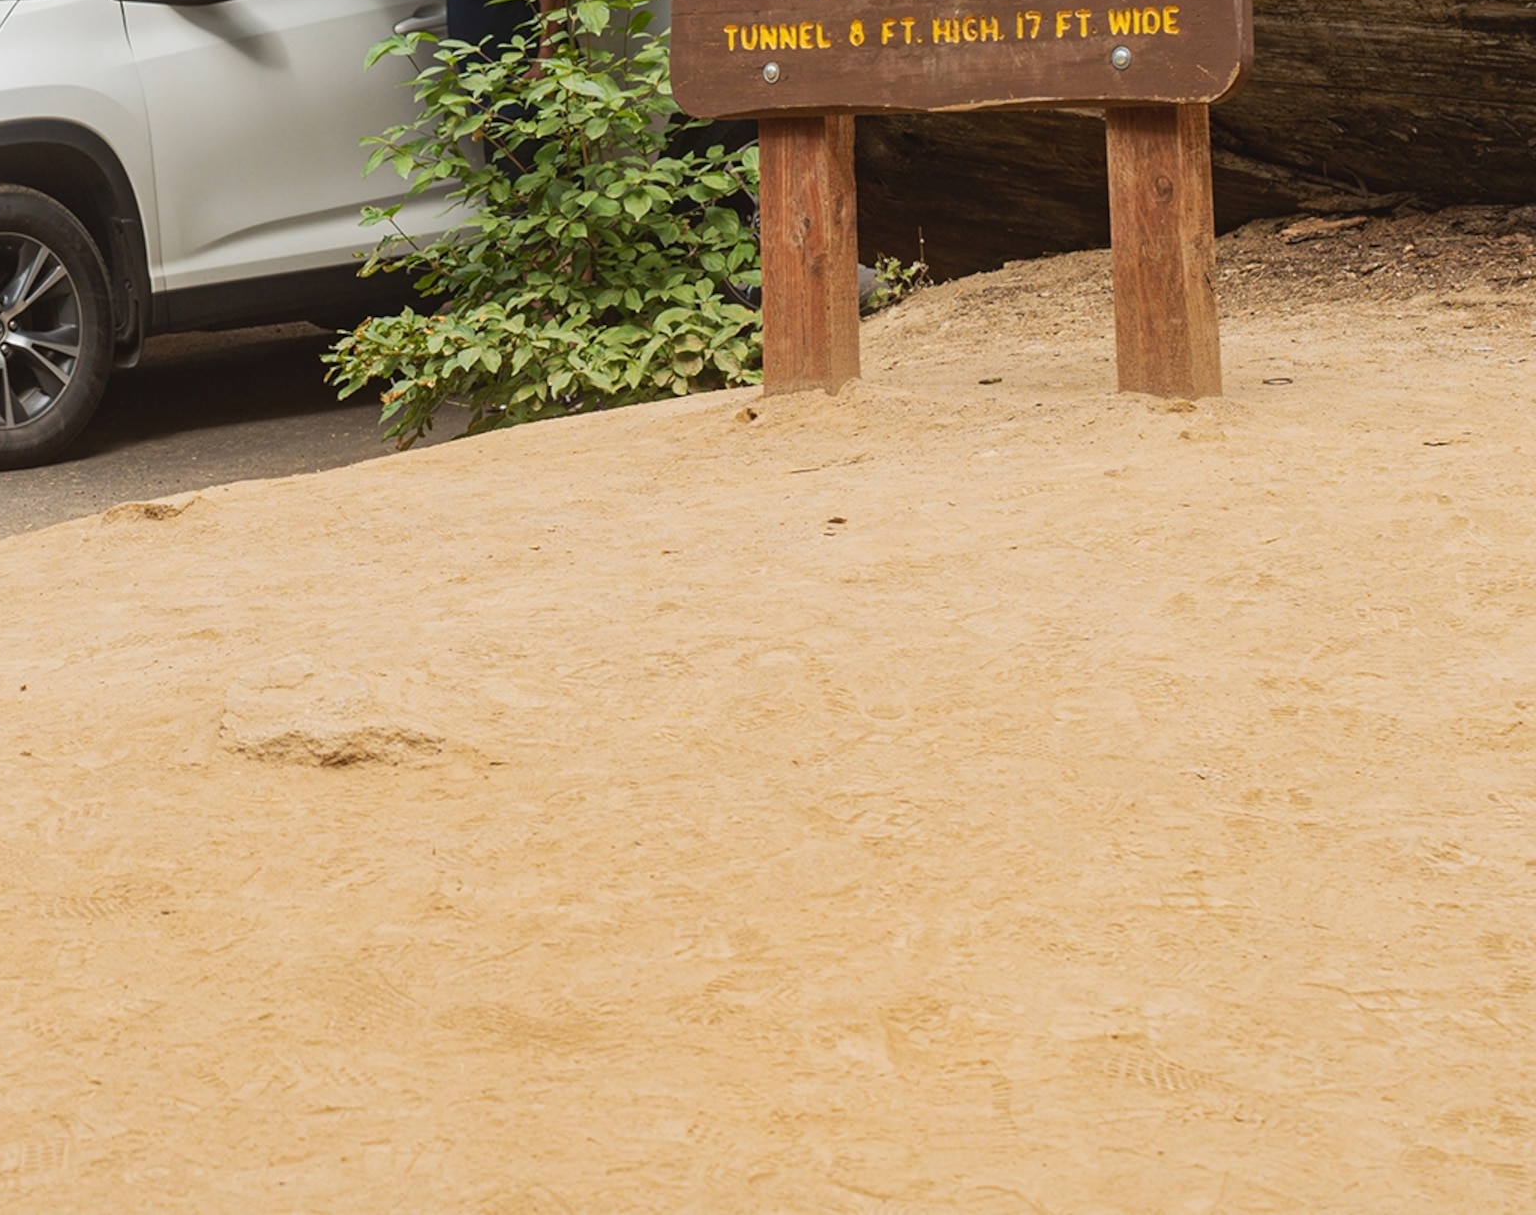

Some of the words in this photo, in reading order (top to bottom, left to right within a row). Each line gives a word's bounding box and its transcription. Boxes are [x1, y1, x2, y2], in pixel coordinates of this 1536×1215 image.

[722, 19, 833, 52] TUNNEL
[847, 18, 867, 47] 8
[880, 16, 923, 45] FT.
[1015, 10, 1043, 41] 17
[1107, 5, 1181, 36] WIDE
